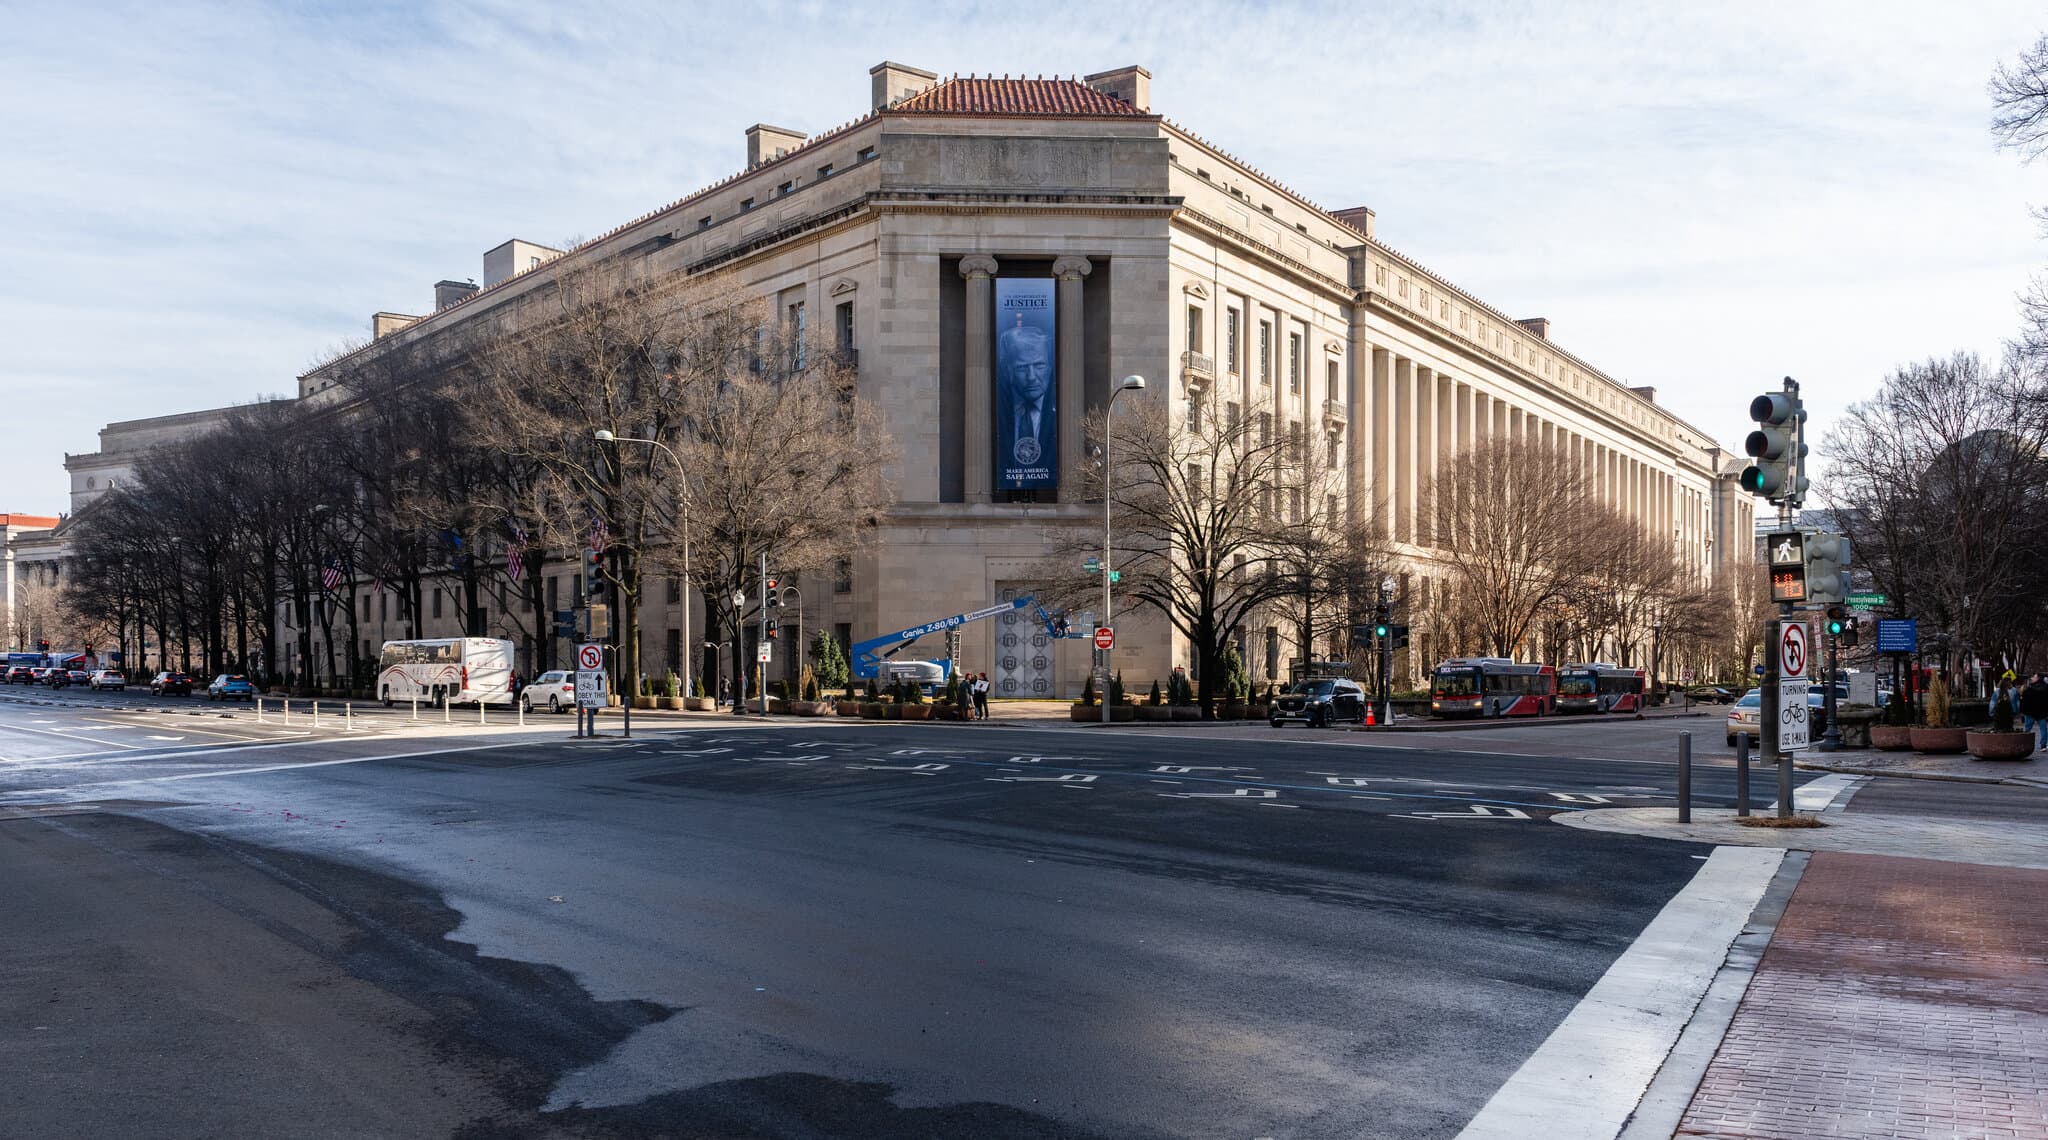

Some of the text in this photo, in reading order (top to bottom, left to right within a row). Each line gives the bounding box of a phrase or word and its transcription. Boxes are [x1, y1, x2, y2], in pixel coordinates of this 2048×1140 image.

[1004, 299, 1048, 307] JUSTICE
[902, 616, 960, 639] Genie Z-80/60
[1782, 684, 1807, 696] TURNING
[1781, 733, 1791, 745] USE
